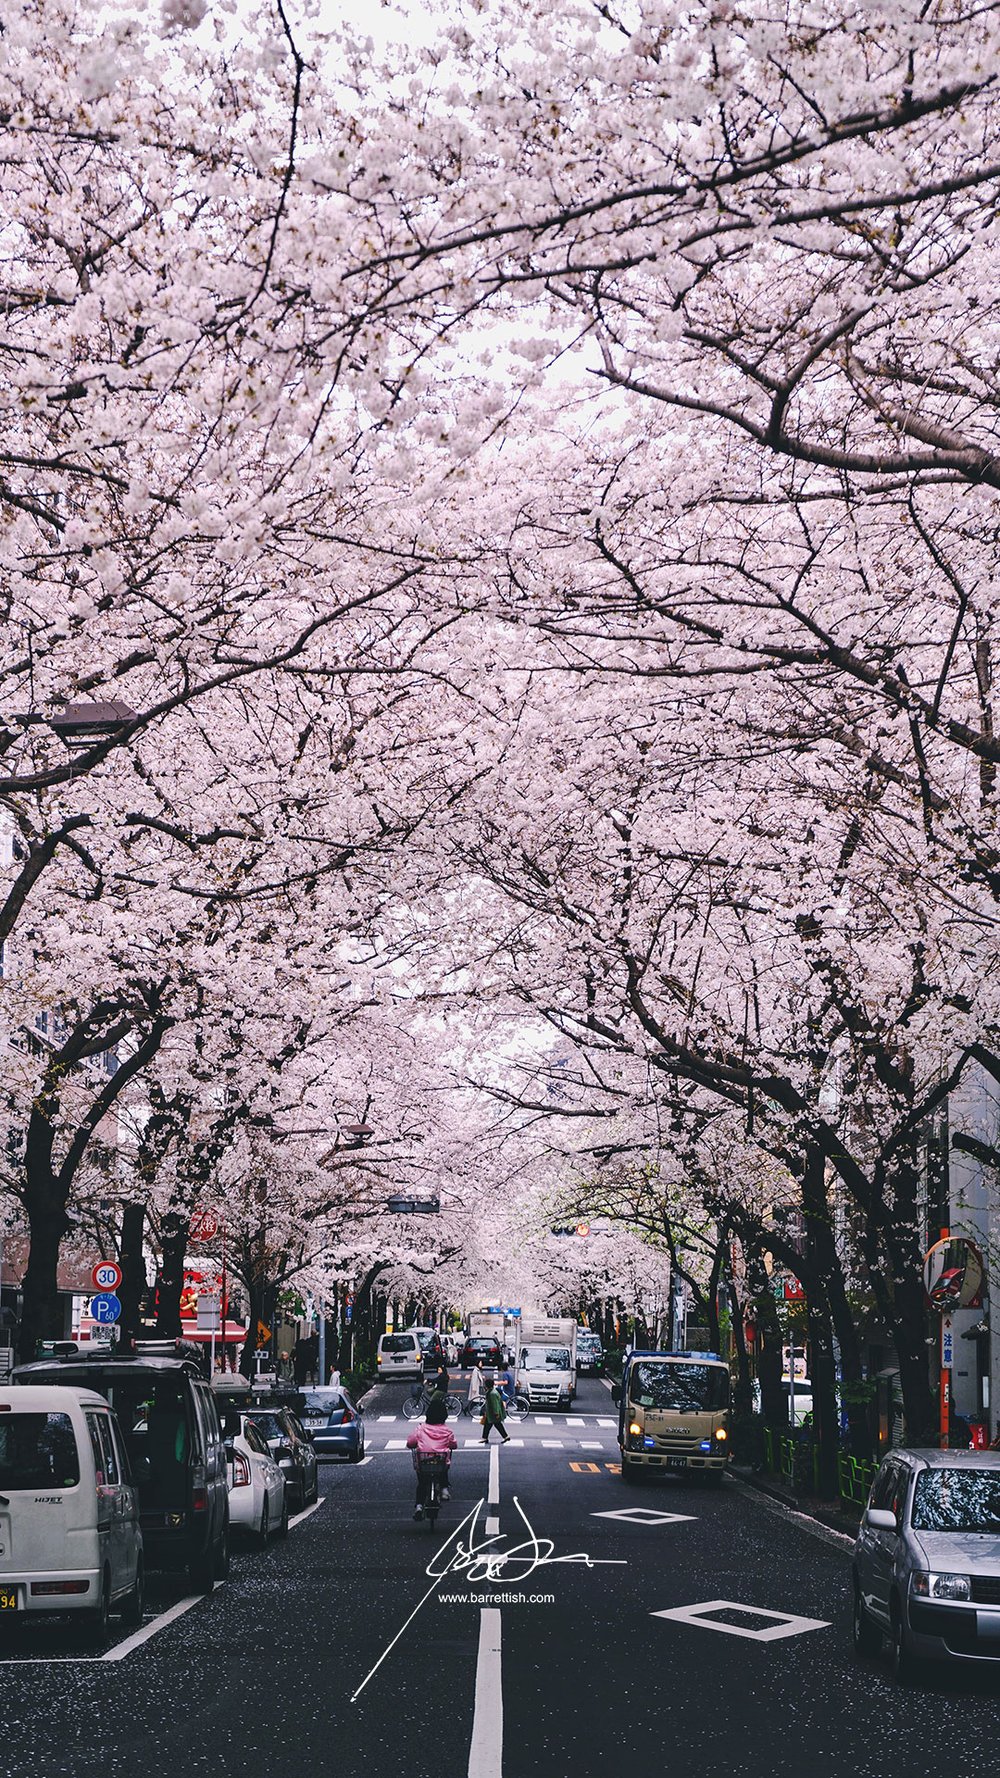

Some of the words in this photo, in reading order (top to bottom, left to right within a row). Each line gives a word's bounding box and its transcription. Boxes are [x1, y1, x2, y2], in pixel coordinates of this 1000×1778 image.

[99, 1270, 116, 1283] 30
[98, 1301, 109, 1320] P
[105, 1311, 114, 1320] 60
[944, 1333, 952, 1362] 注意
